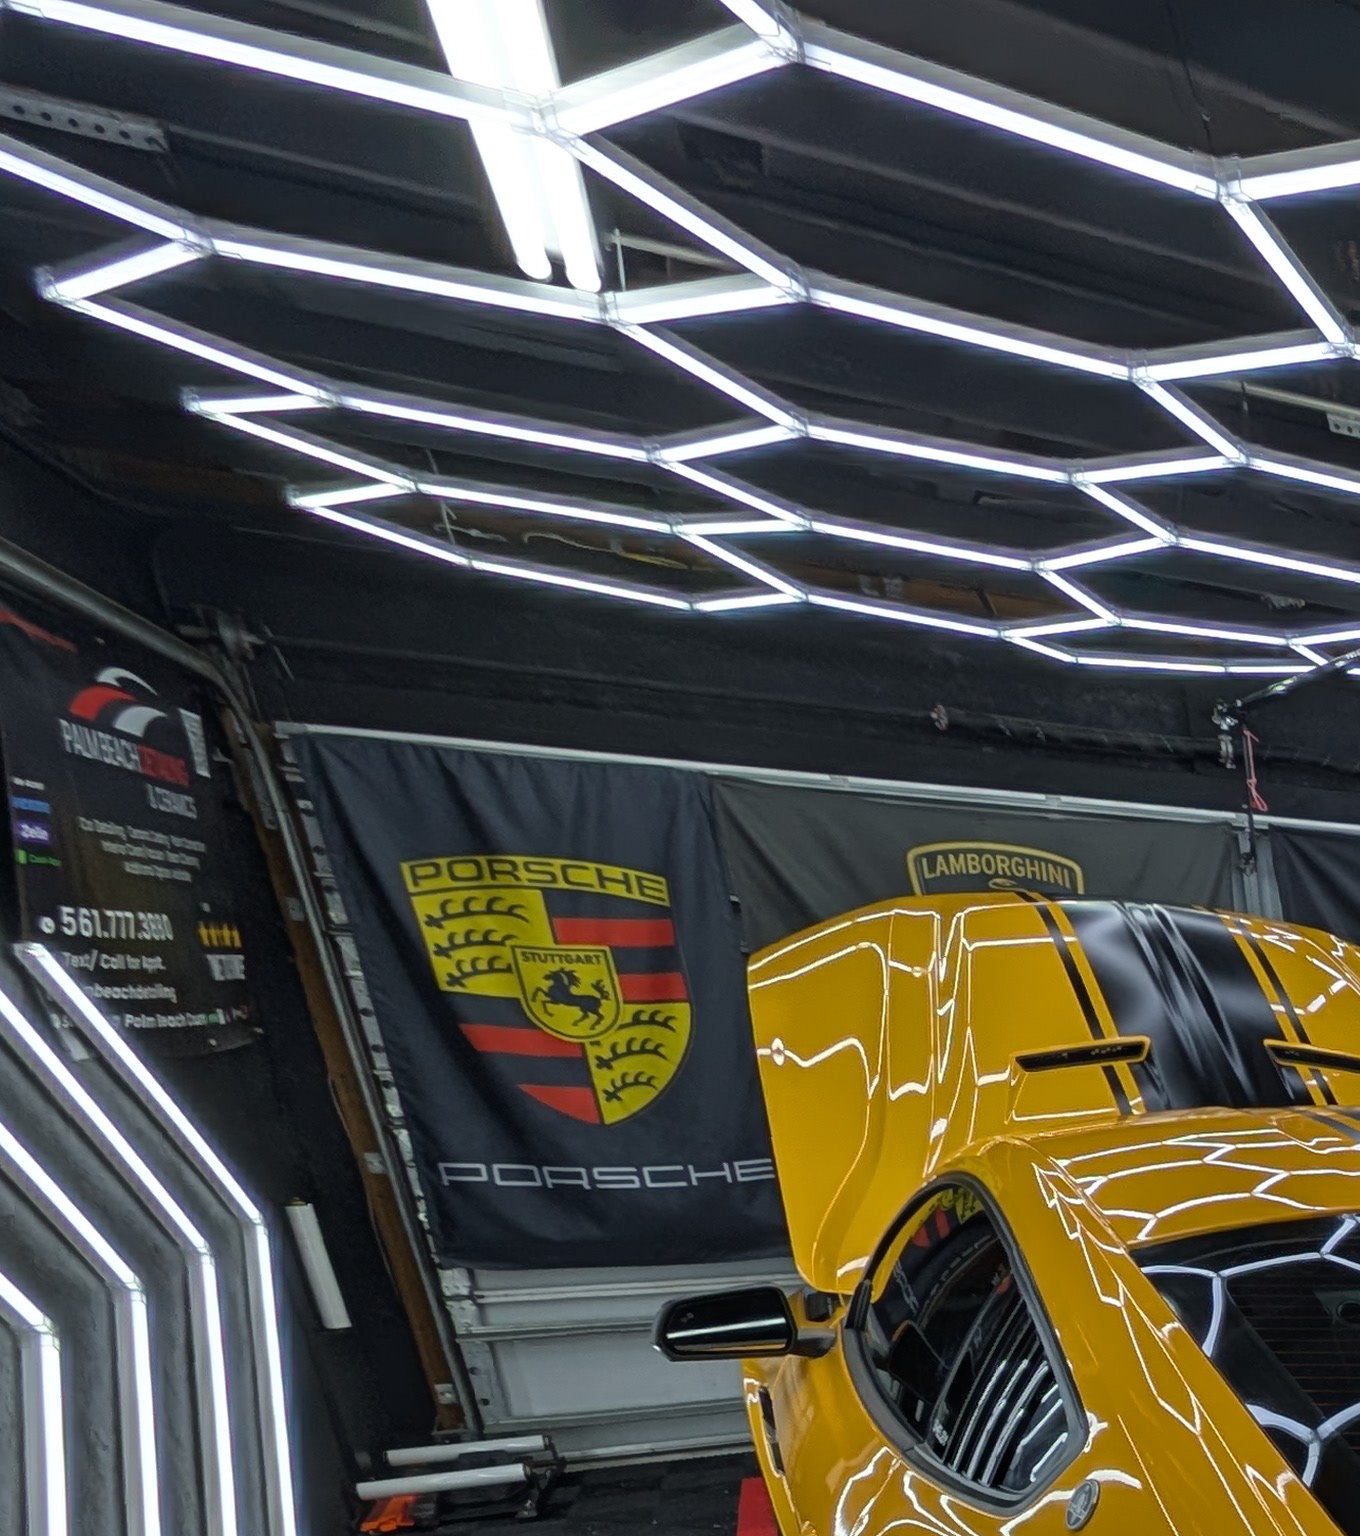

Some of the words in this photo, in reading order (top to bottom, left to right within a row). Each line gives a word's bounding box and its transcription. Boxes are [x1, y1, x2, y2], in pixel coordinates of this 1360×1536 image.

[408, 857, 670, 902] PORSCHE
[921, 853, 1073, 892] LAMBORGHINI
[520, 951, 604, 969] STUTTGART
[437, 1158, 776, 1190] PORSCHE
